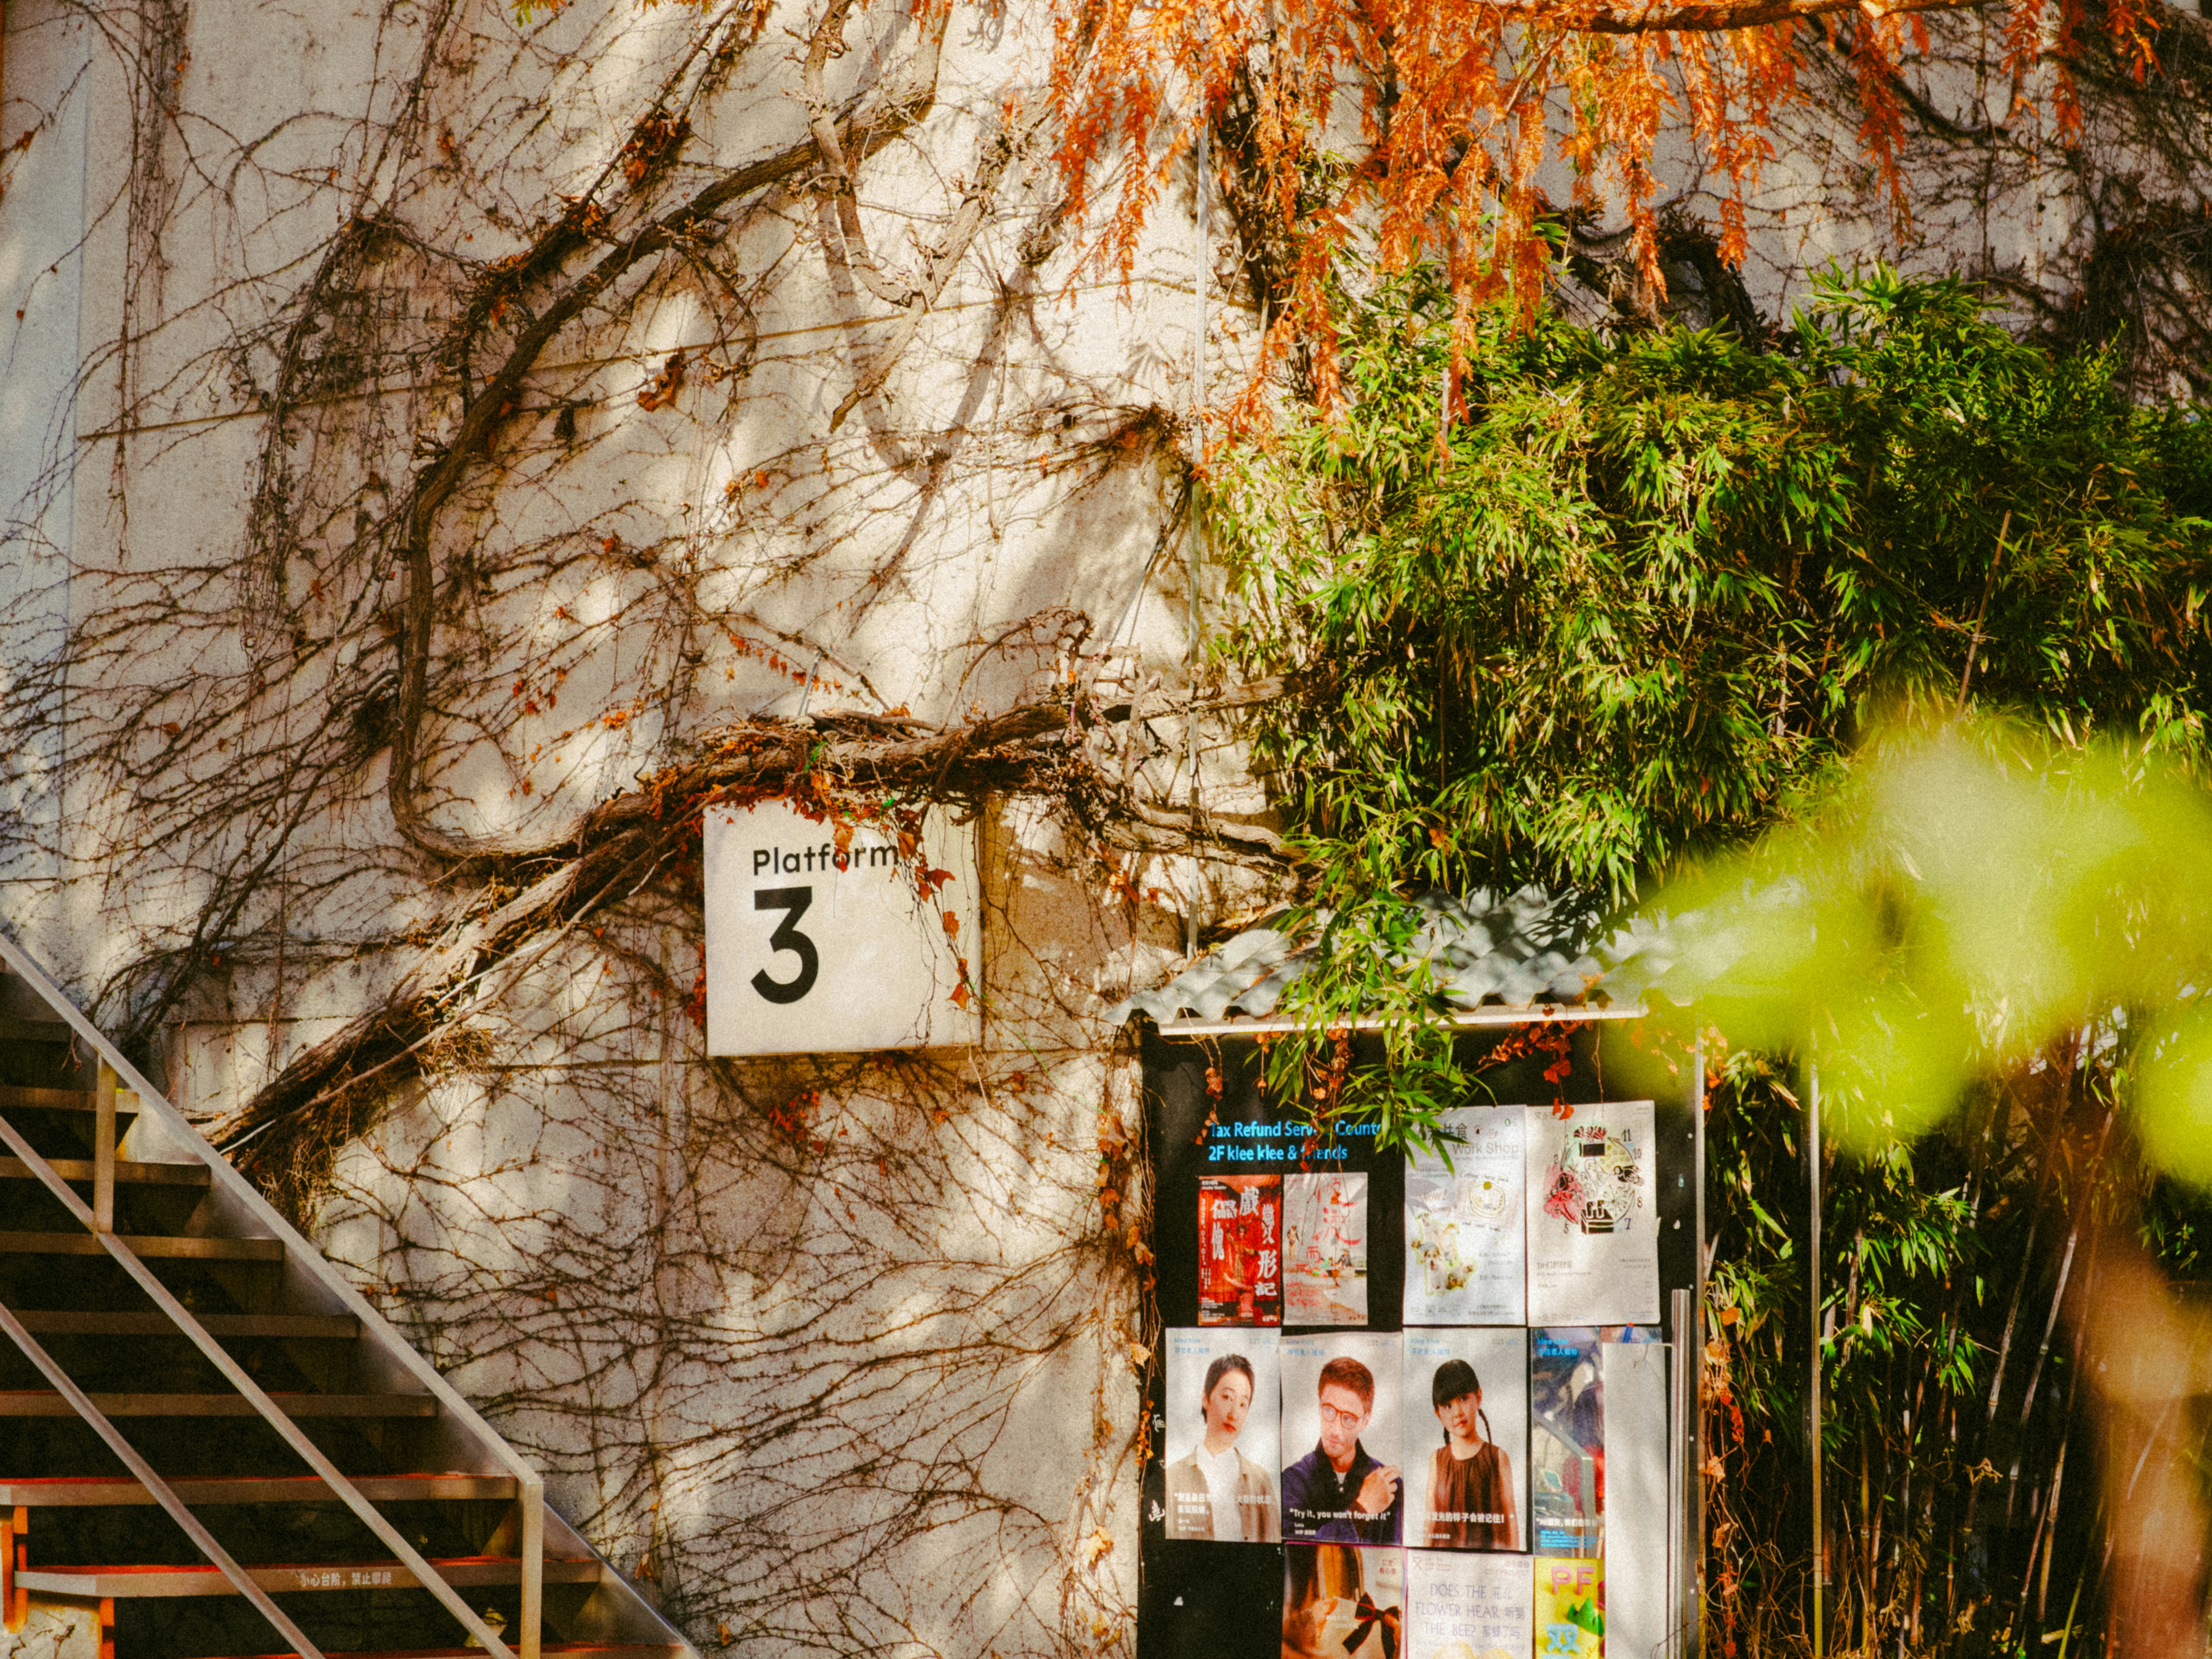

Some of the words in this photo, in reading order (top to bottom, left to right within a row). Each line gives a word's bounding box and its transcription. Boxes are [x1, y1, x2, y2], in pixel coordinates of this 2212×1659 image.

[754, 843, 899, 875] Platform
[751, 886, 819, 1004] 3
[1235, 1120, 1281, 1137] Refund
[1284, 1120, 1329, 1137] Serv
[1335, 1120, 1381, 1135] Count
[1622, 1129, 1631, 1142] 11
[1208, 1145, 1225, 1161] 2F
[1227, 1144, 1254, 1161] klee
[1257, 1144, 1284, 1160] klee
[1287, 1144, 1297, 1160] &
[1452, 1143, 1482, 1155] Work
[1486, 1142, 1519, 1156] Shop
[1632, 1148, 1642, 1159] 10
[1637, 1196, 1643, 1208] 8
[1564, 1222, 1569, 1234] 5
[1625, 1218, 1632, 1230] 7
[1317, 1511, 1331, 1520] you
[1354, 1510, 1378, 1521] forget
[1551, 1565, 1594, 1596] PF
[1431, 1583, 1459, 1597] DOES
[1465, 1585, 1487, 1599] THE
[1415, 1601, 1462, 1616] FLOWER
[1467, 1604, 1500, 1619] HEAR
[1424, 1622, 1445, 1635] THE
[1452, 1623, 1476, 1637] BEE?
